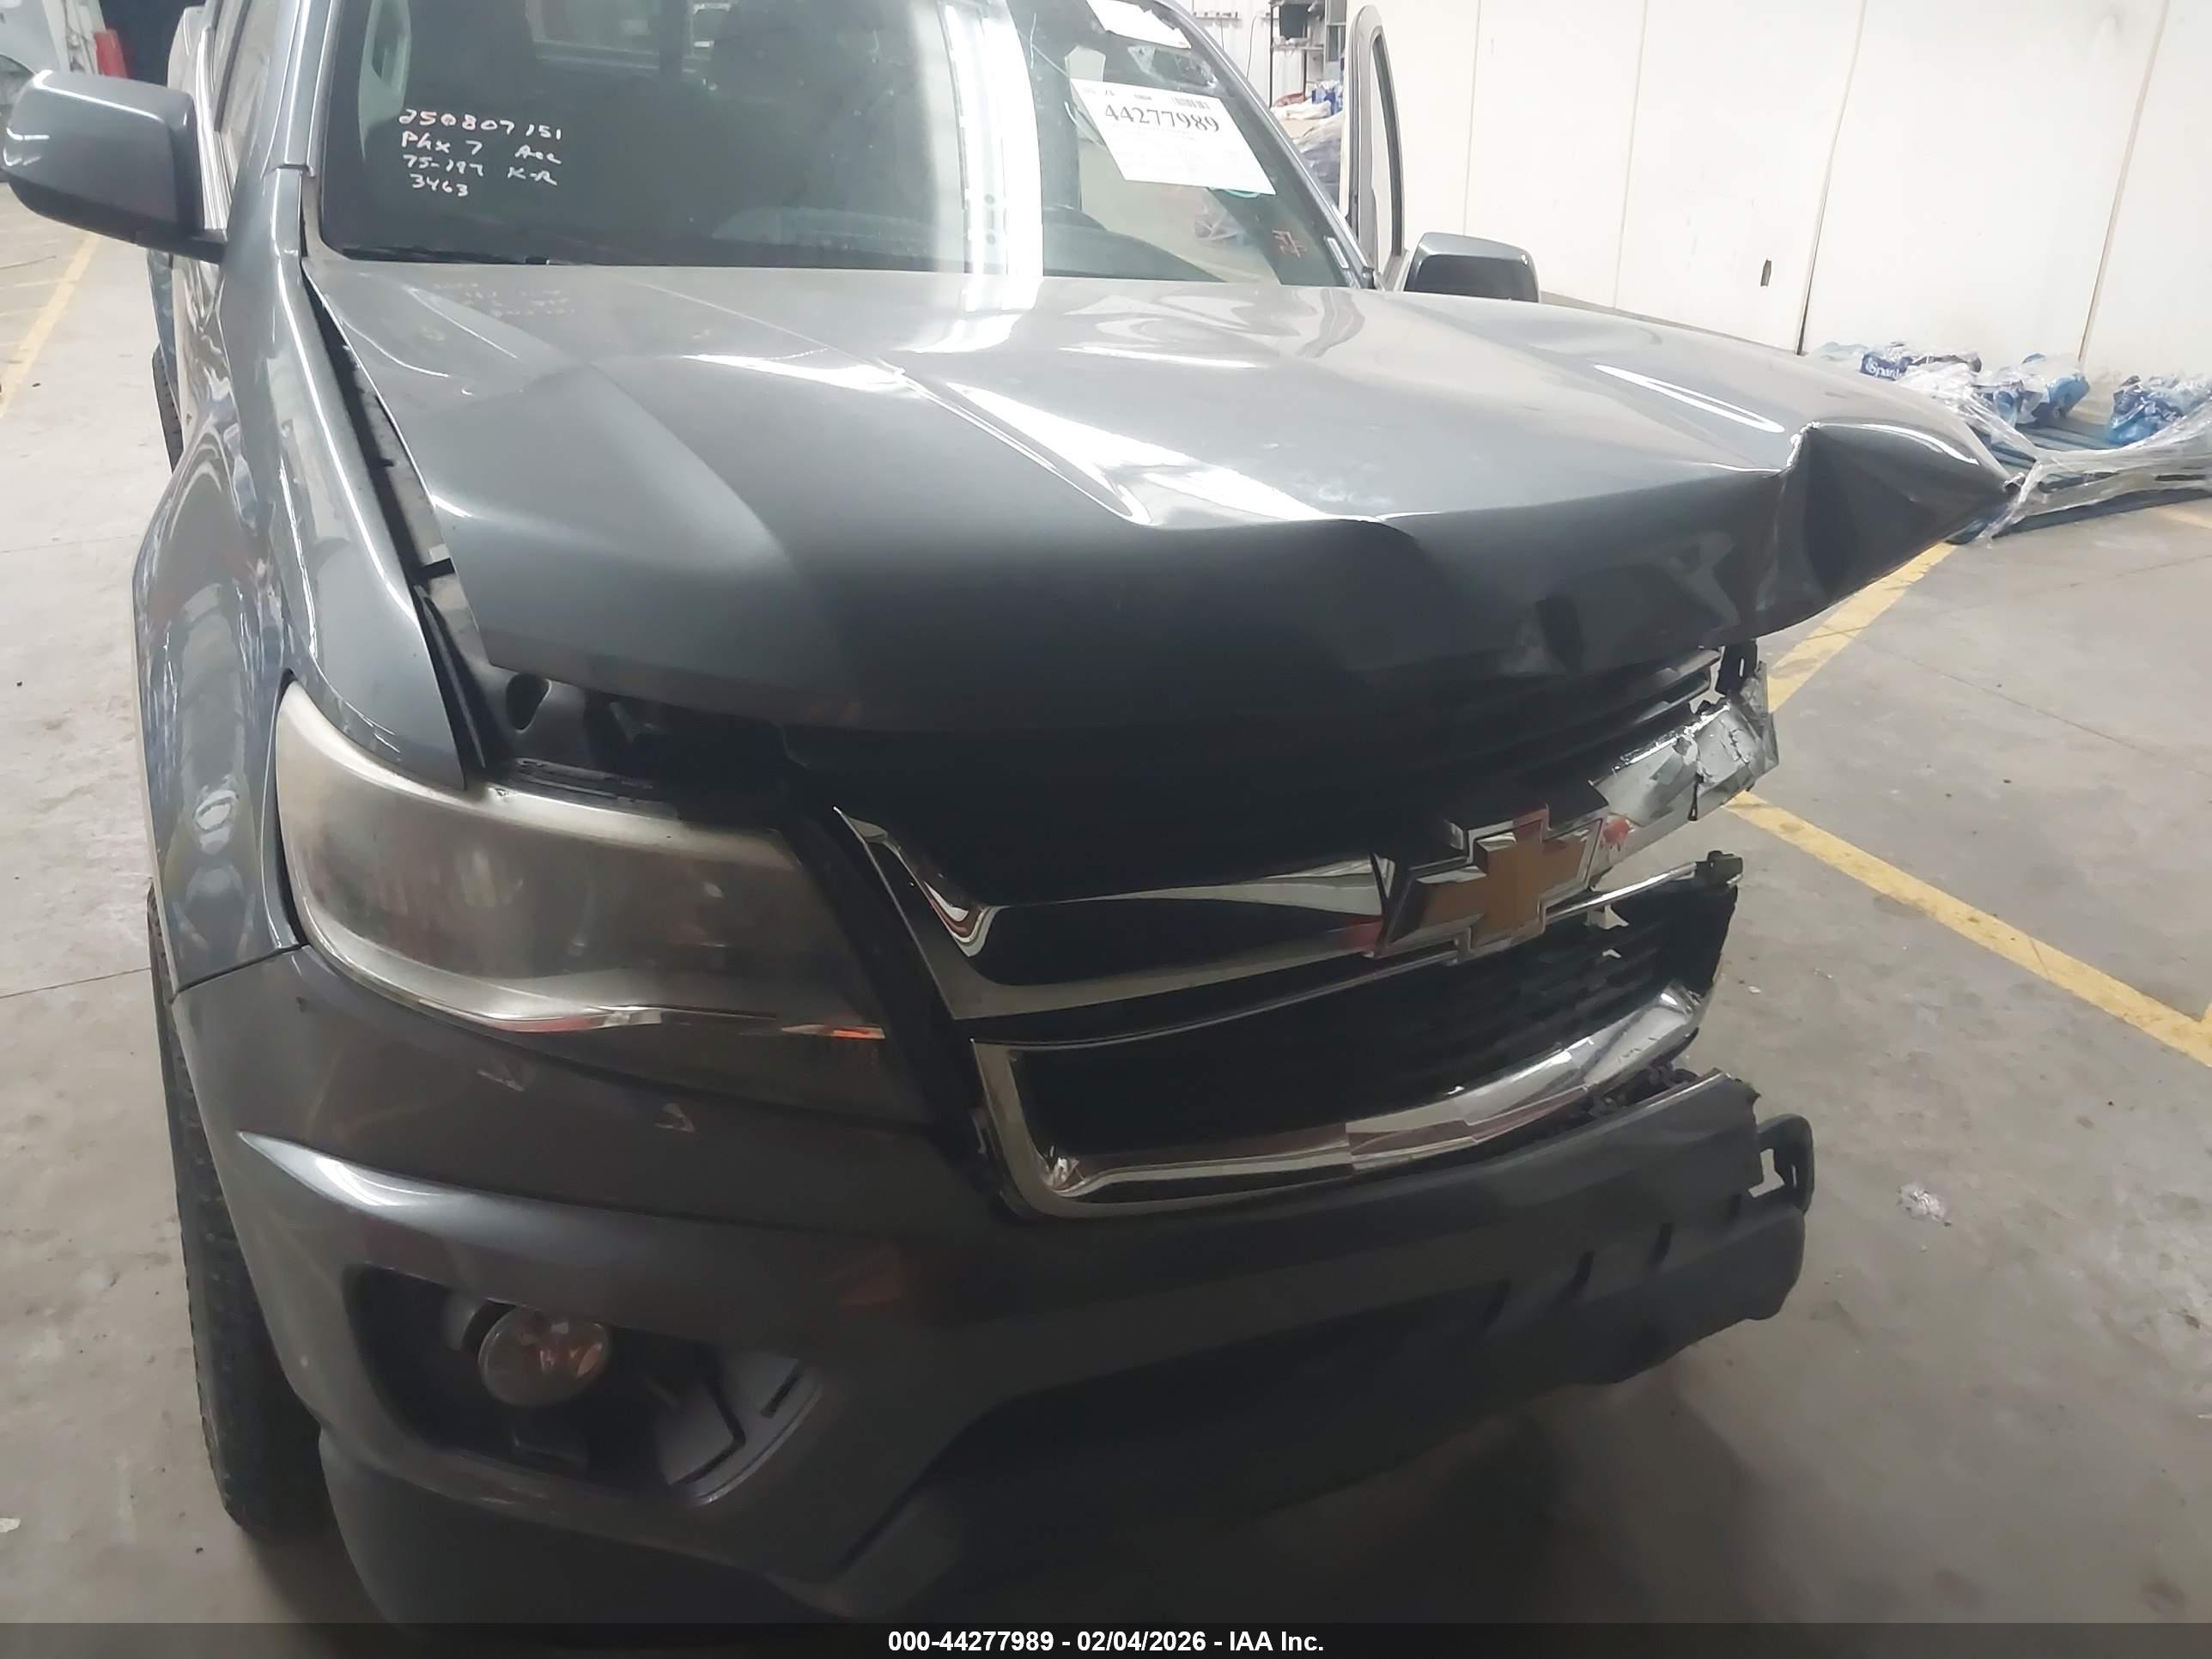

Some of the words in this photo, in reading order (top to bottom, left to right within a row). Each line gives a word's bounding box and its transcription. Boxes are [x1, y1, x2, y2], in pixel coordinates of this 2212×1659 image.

[1105, 104, 1219, 131] 44277989
[465, 139, 483, 155] 7
[409, 173, 470, 198] 3463
